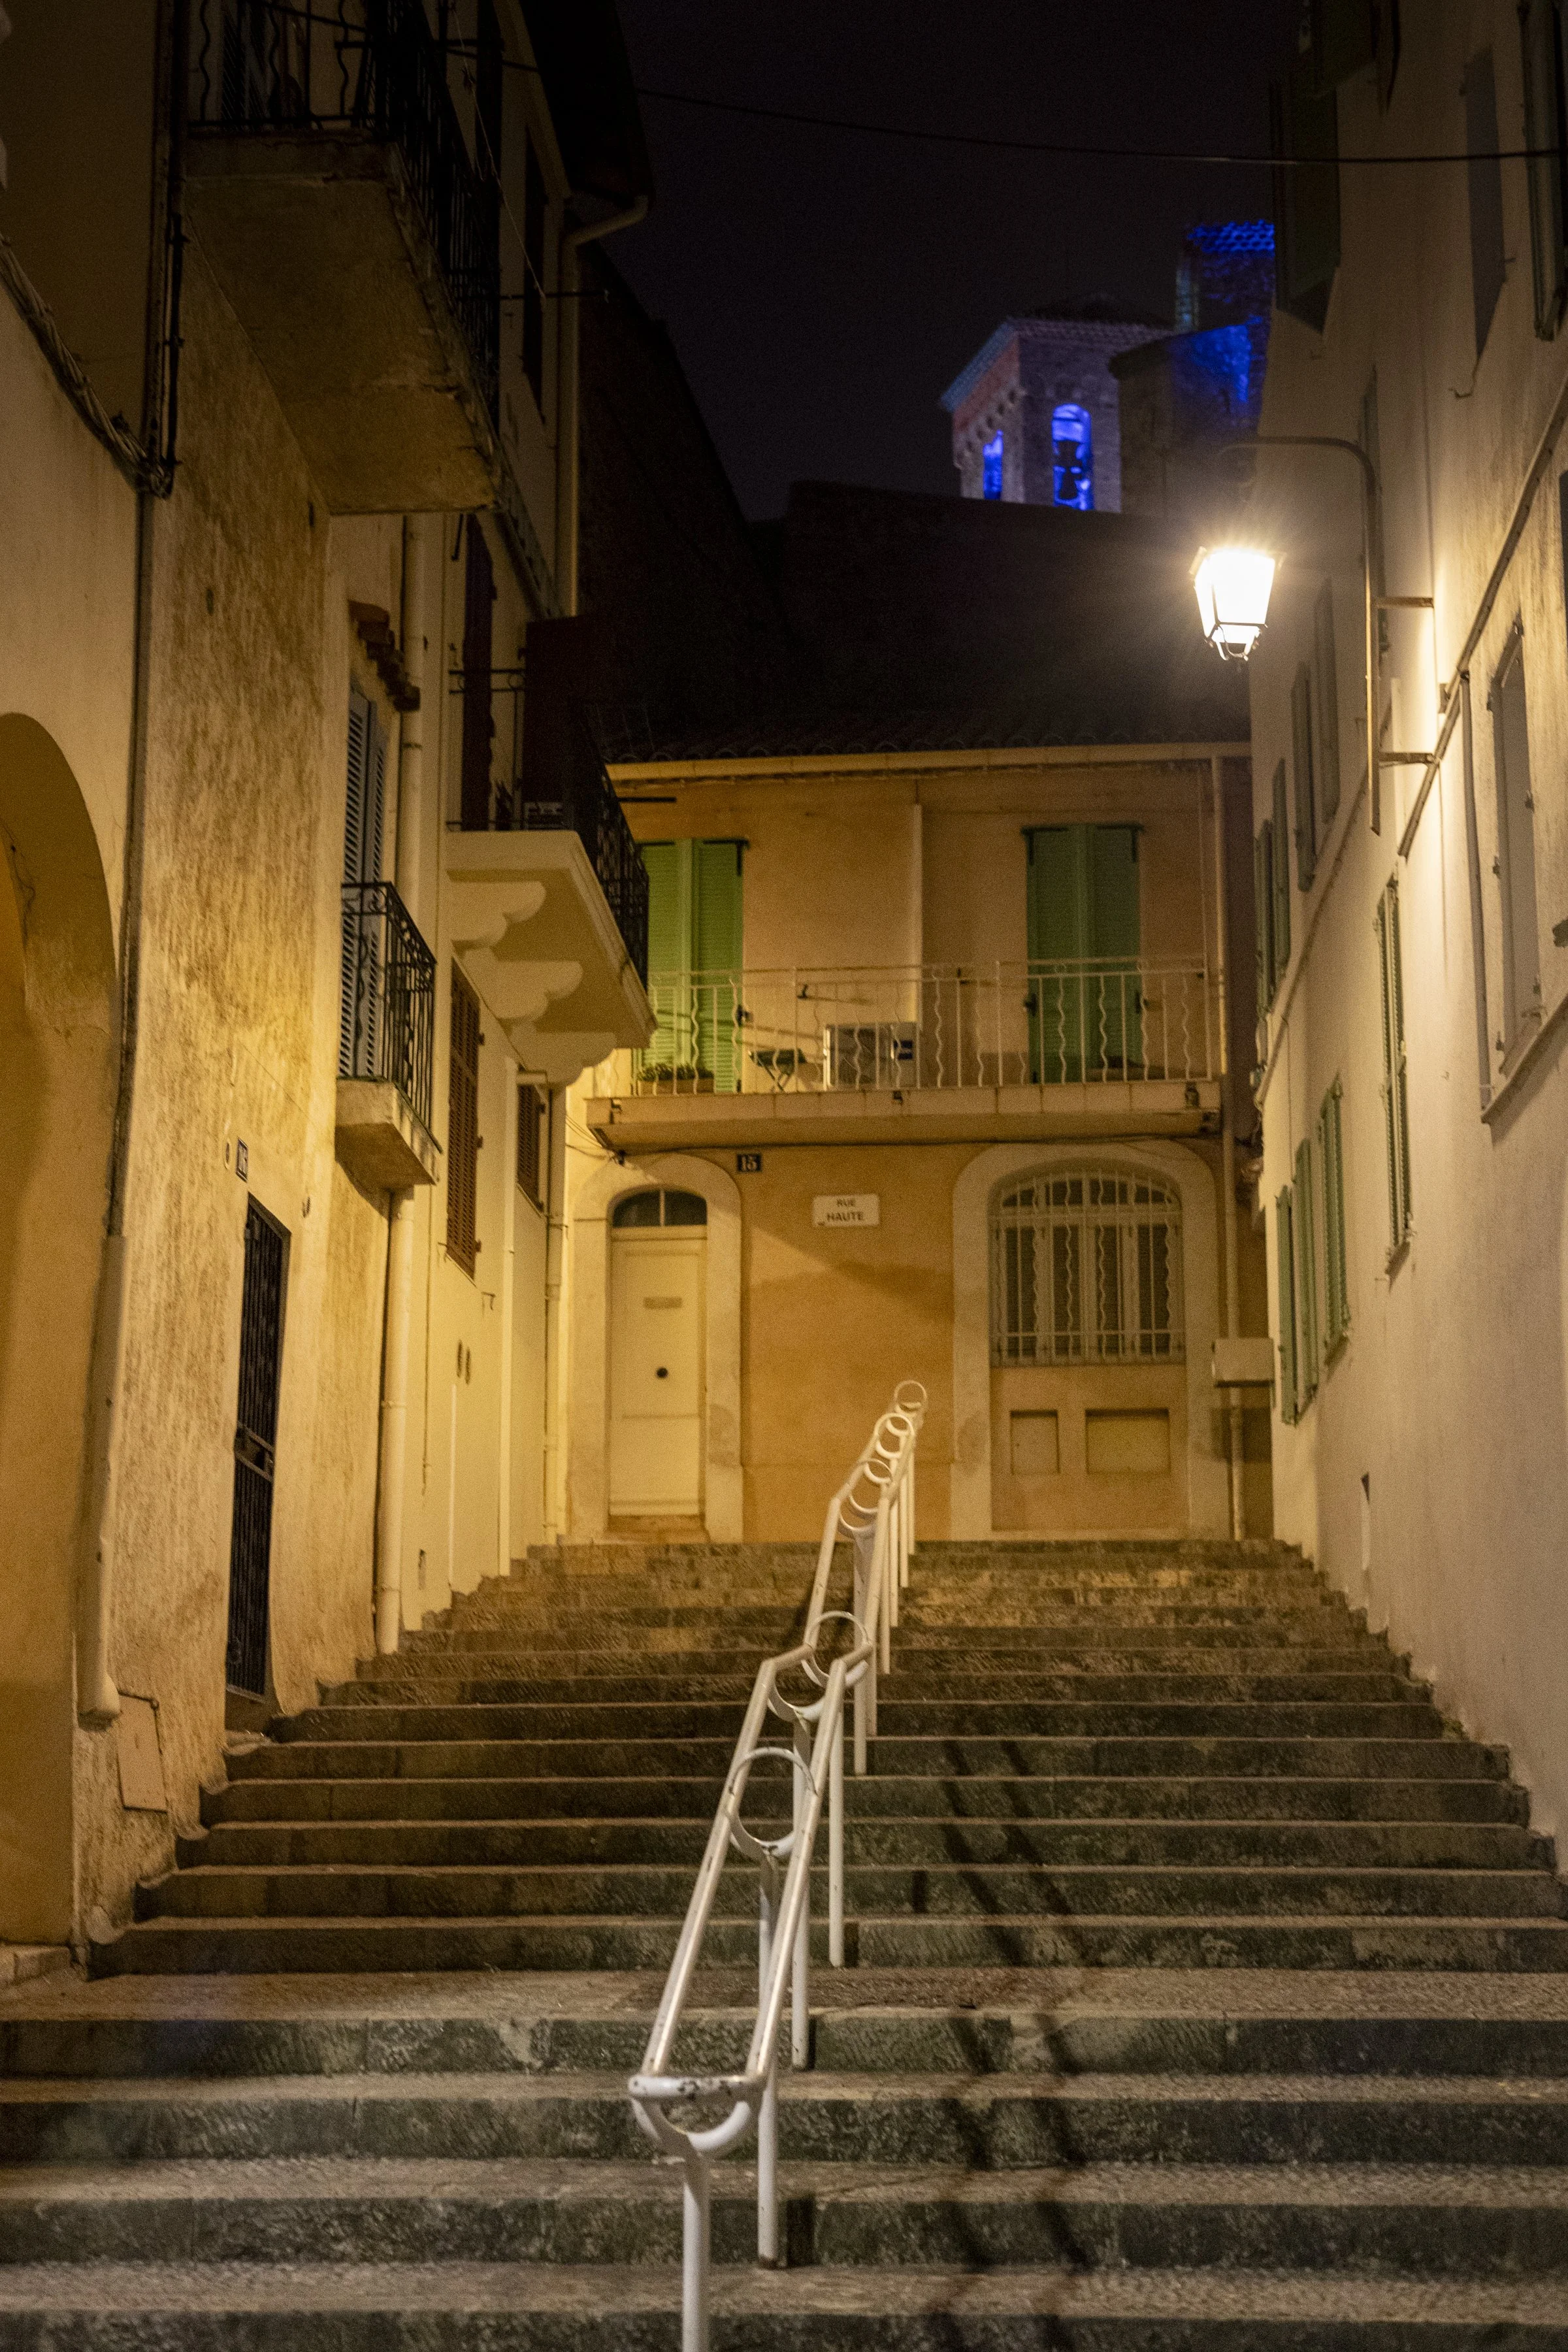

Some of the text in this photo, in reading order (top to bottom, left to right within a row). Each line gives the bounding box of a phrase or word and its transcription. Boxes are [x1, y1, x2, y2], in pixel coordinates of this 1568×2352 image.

[742, 1154, 757, 1170] 15
[836, 1198, 856, 1207] RUE
[826, 1210, 863, 1221] HAUTE
